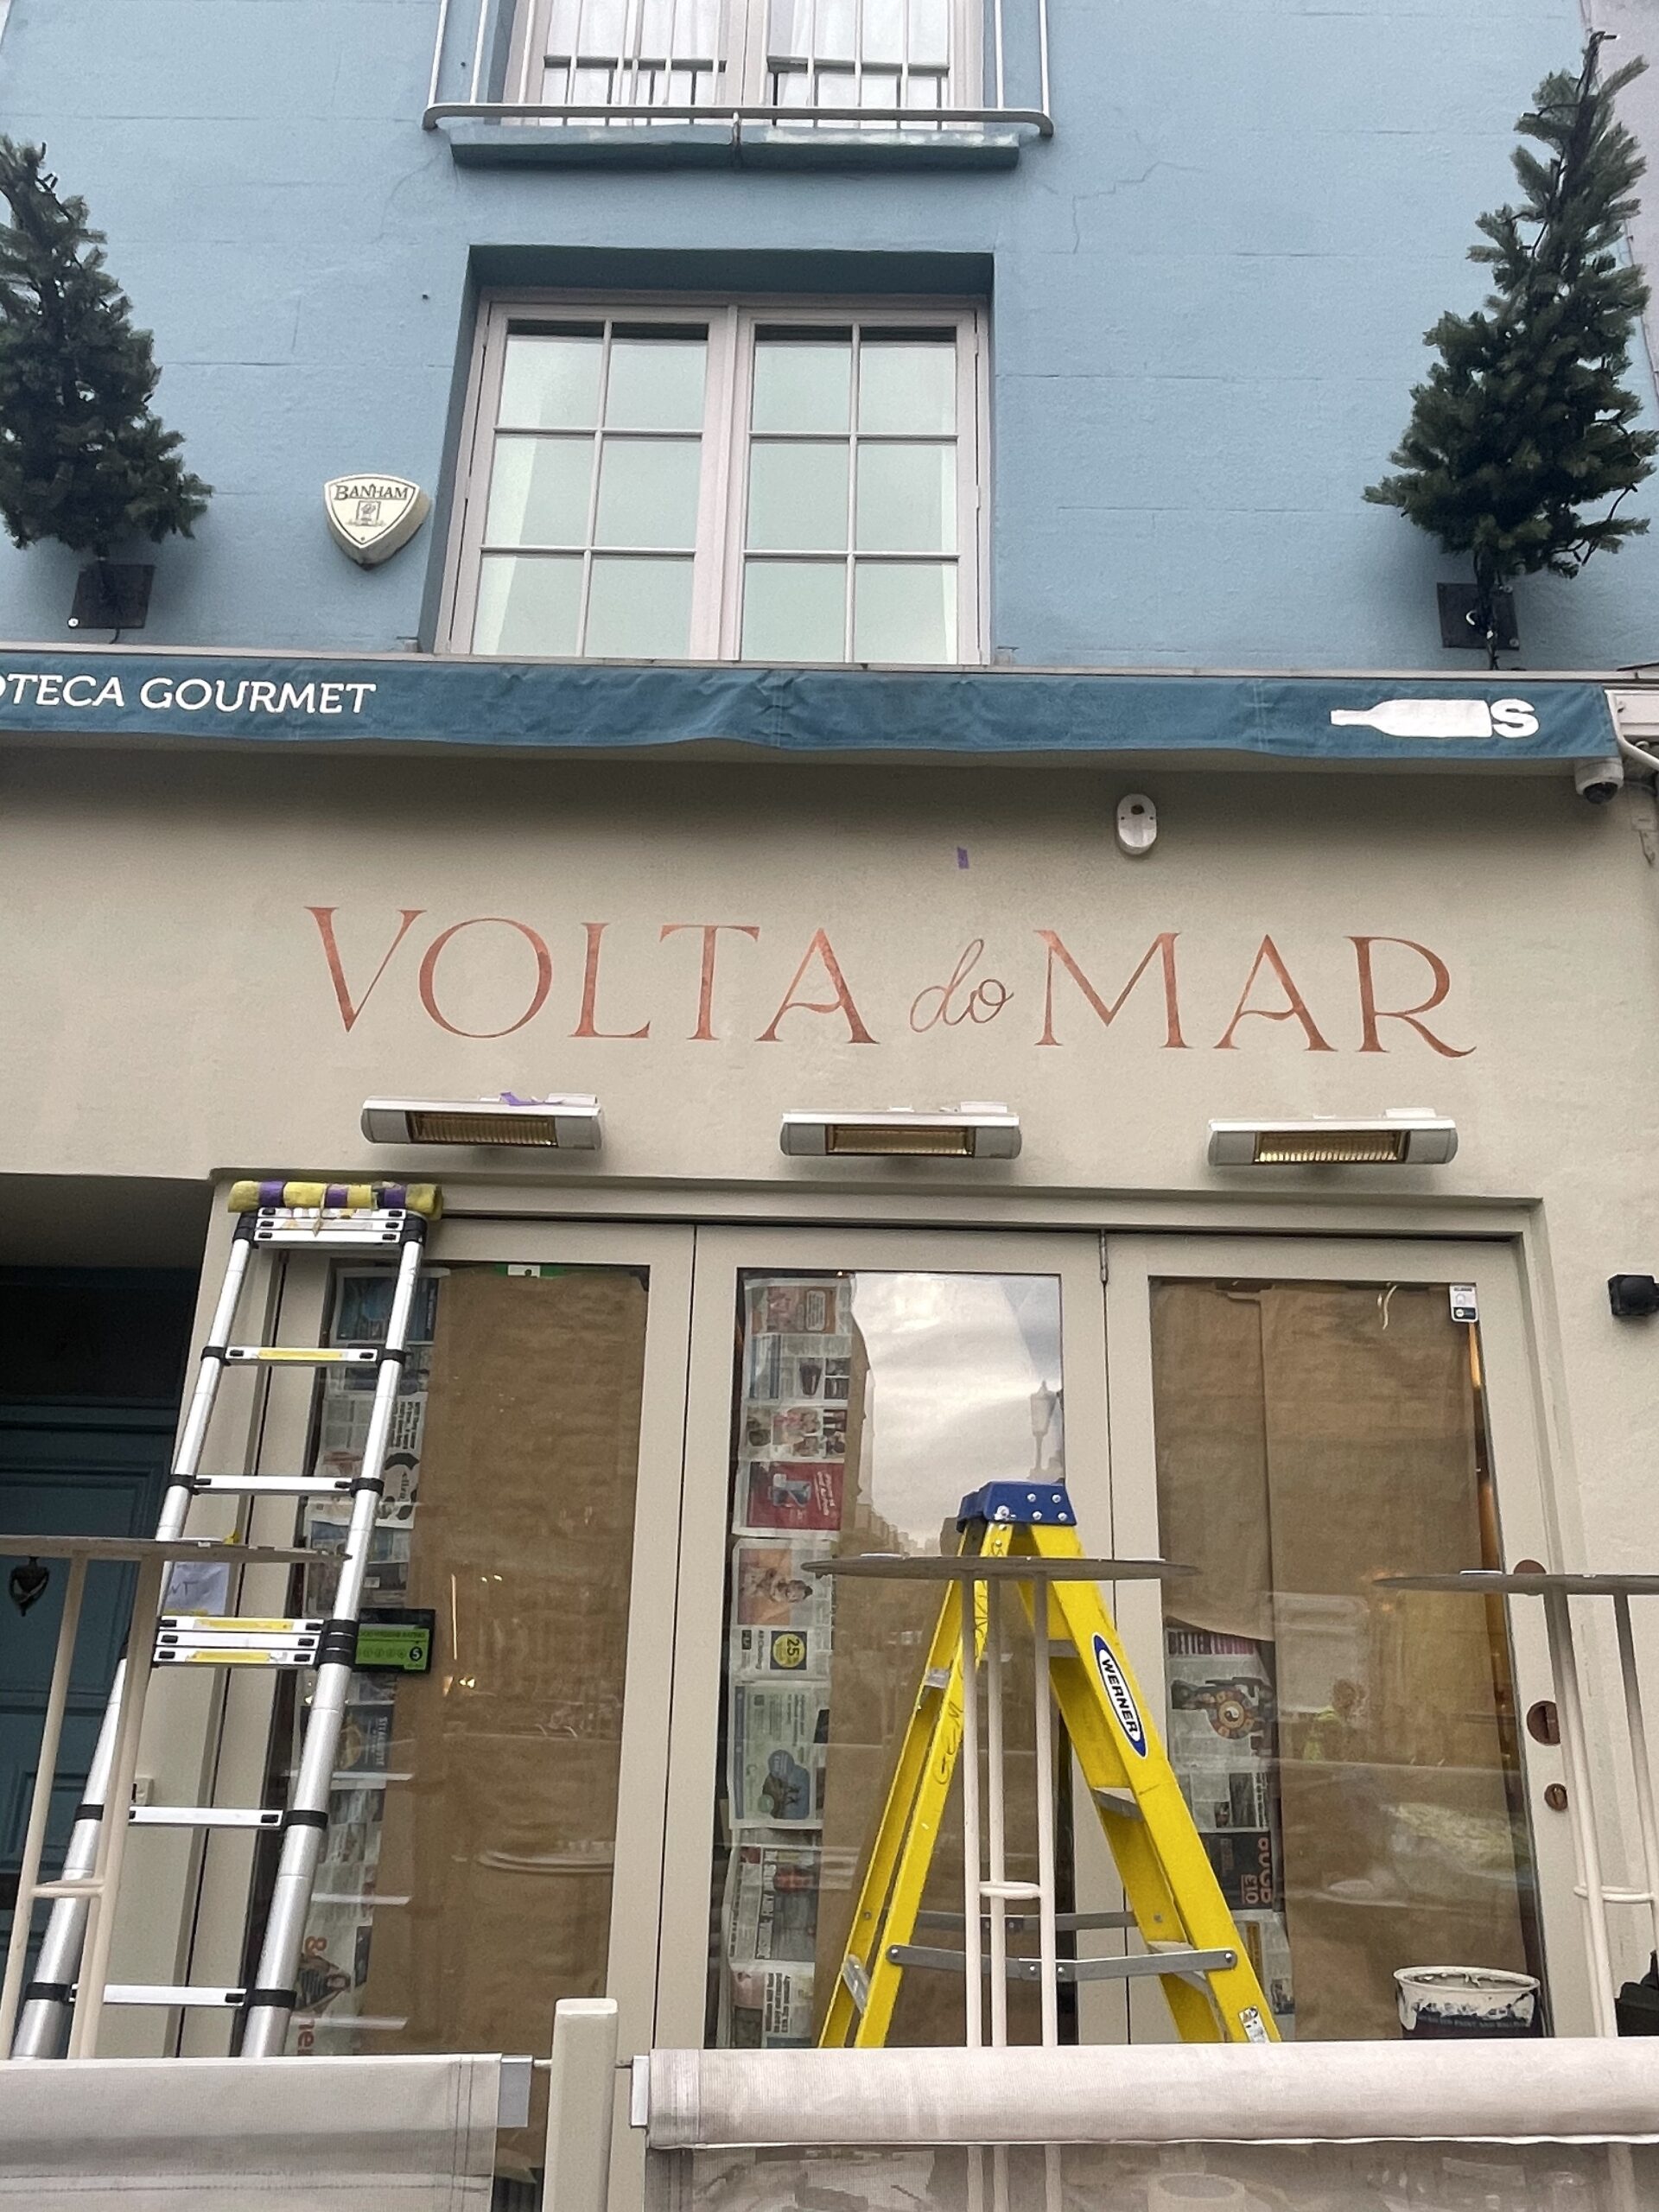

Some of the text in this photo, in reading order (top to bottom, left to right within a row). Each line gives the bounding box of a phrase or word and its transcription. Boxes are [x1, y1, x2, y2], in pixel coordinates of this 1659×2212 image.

[334, 484, 409, 500] BANHAM
[140, 677, 376, 714] GOURMET
[303, 906, 1478, 1058] VOLTA do MAR
[1102, 1659, 1138, 1732] WERNER
